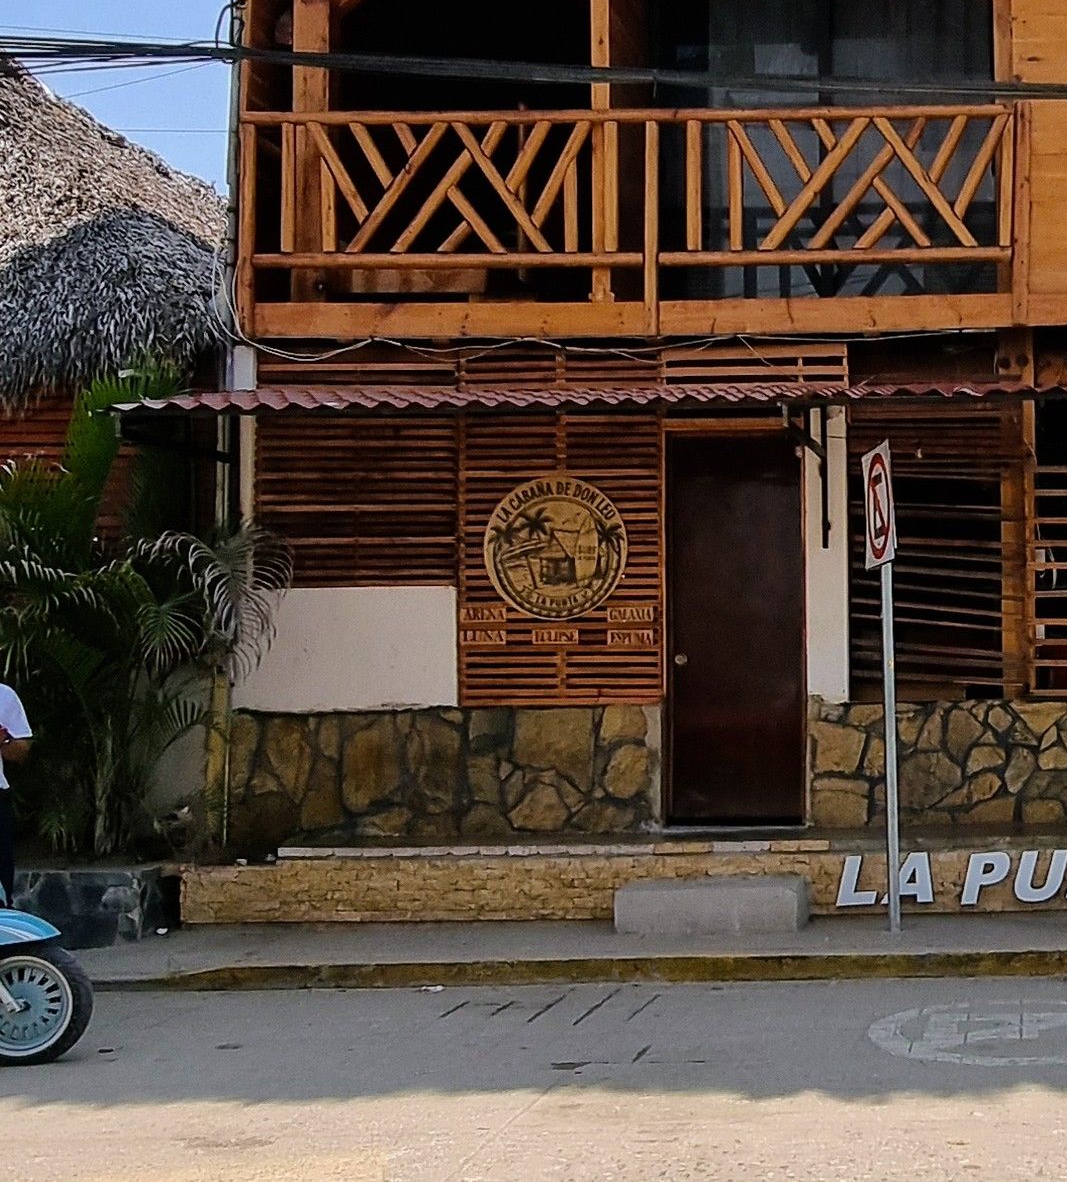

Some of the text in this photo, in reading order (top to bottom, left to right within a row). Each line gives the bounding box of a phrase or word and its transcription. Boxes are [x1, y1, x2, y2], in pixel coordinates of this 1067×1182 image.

[496, 481, 617, 523] LA CABAÑA DE DON LEO
[463, 607, 505, 621] ARENA
[463, 629, 504, 642] LUNA
[836, 852, 934, 907] LA
